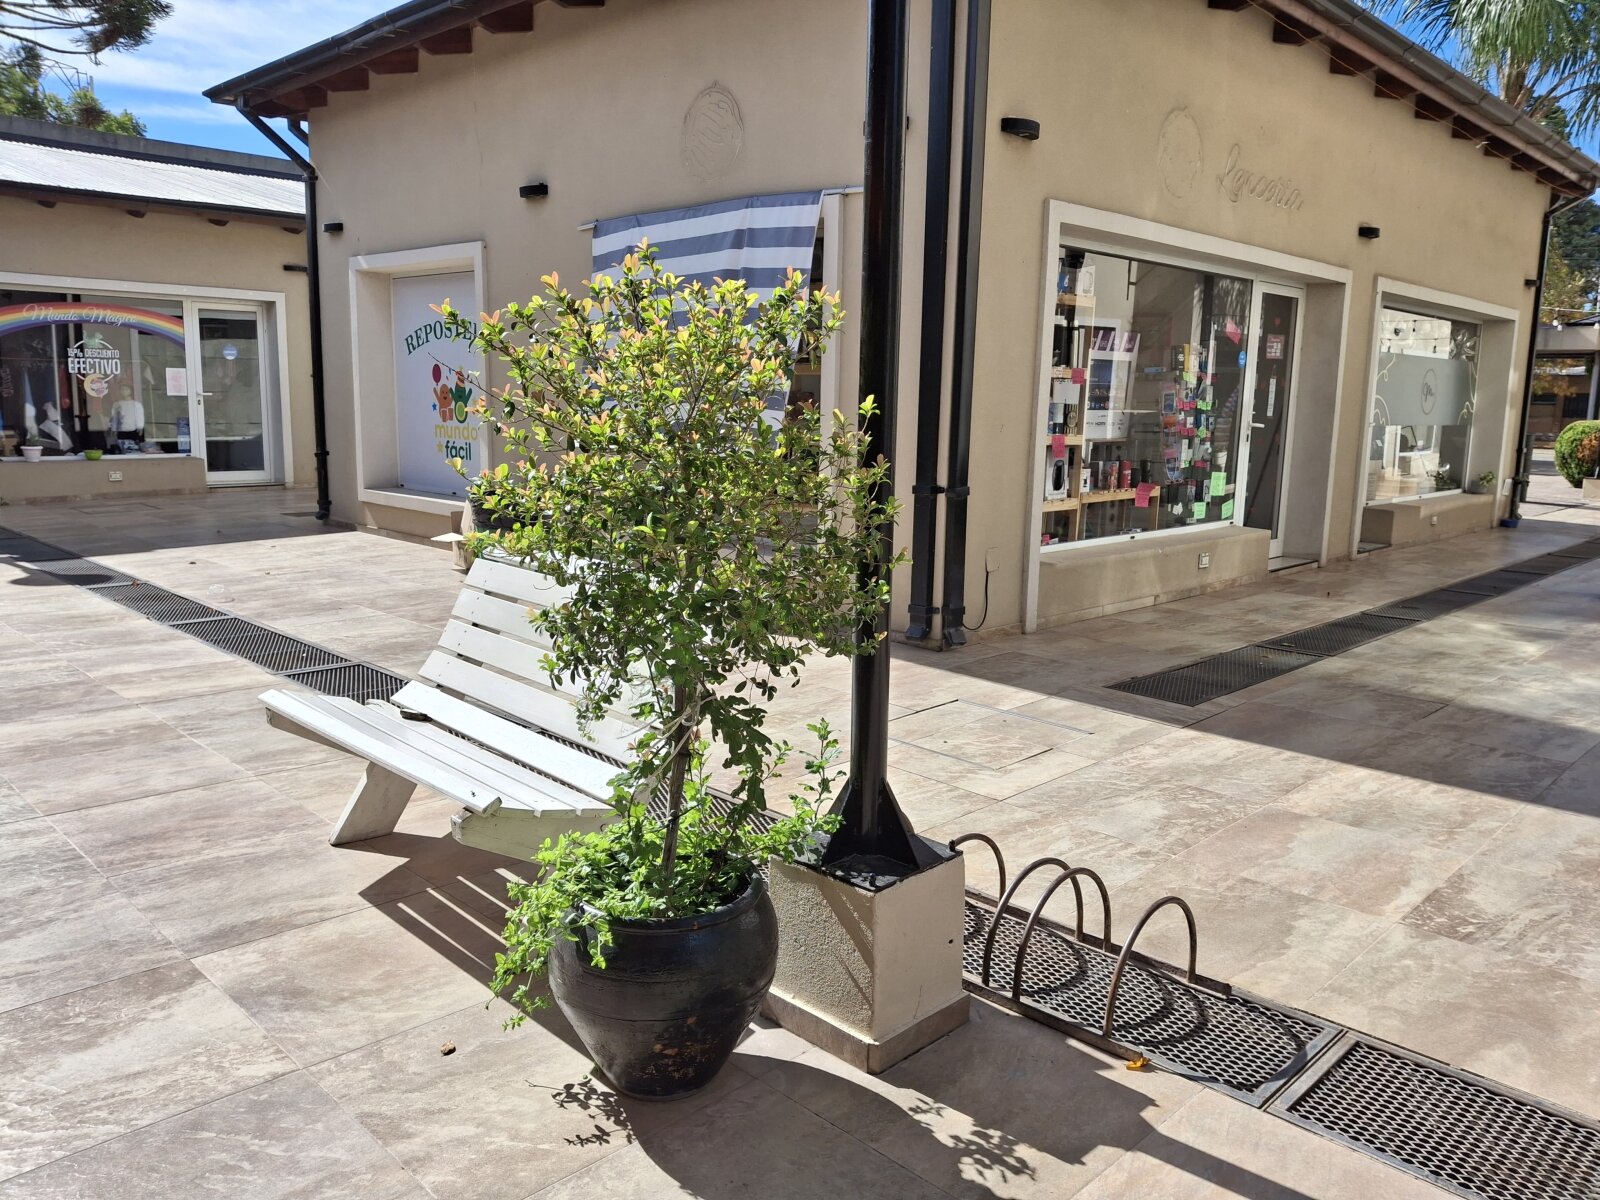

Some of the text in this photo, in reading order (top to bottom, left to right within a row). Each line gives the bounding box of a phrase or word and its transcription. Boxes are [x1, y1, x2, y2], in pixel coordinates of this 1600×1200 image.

[404, 319, 478, 356] REPOSTE
[67, 347, 120, 358] 15% DESCUENTO
[67, 357, 121, 375] EFECTIVO
[434, 422, 479, 441] mundo
[444, 441, 472, 461] fácil
